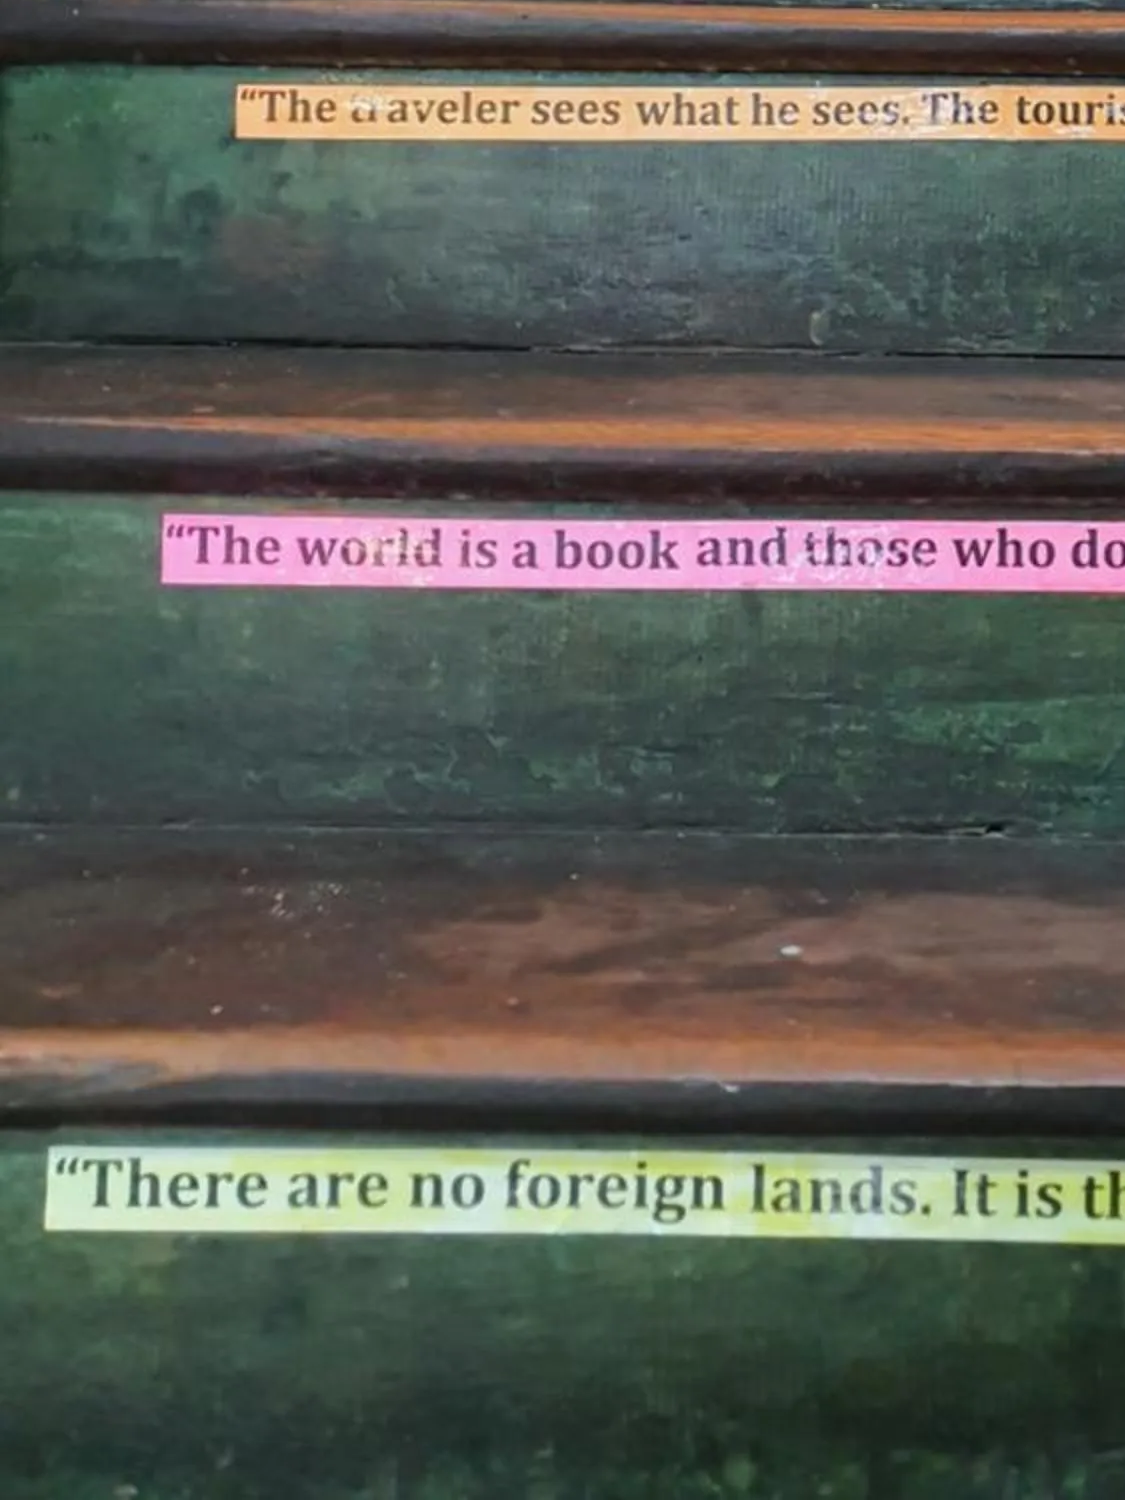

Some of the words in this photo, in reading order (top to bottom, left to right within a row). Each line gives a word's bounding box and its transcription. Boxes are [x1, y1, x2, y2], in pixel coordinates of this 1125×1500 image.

[531, 99, 620, 125] sees
[638, 93, 738, 126] what
[752, 94, 799, 125] he
[812, 98, 910, 126] sees.
[921, 92, 999, 125] The
[299, 528, 443, 568] world
[459, 529, 497, 569] is
[511, 540, 539, 570] a
[553, 530, 680, 570] book
[696, 527, 788, 568] and
[804, 526, 937, 567] those
[955, 528, 1057, 569] who
[55, 1157, 268, 1208] “There
[287, 1170, 389, 1208] are
[408, 1171, 486, 1209] no
[504, 1159, 726, 1224] foreign
[750, 1163, 933, 1216] lands.
[951, 1169, 998, 1218] It
[1015, 1169, 1063, 1219] is
